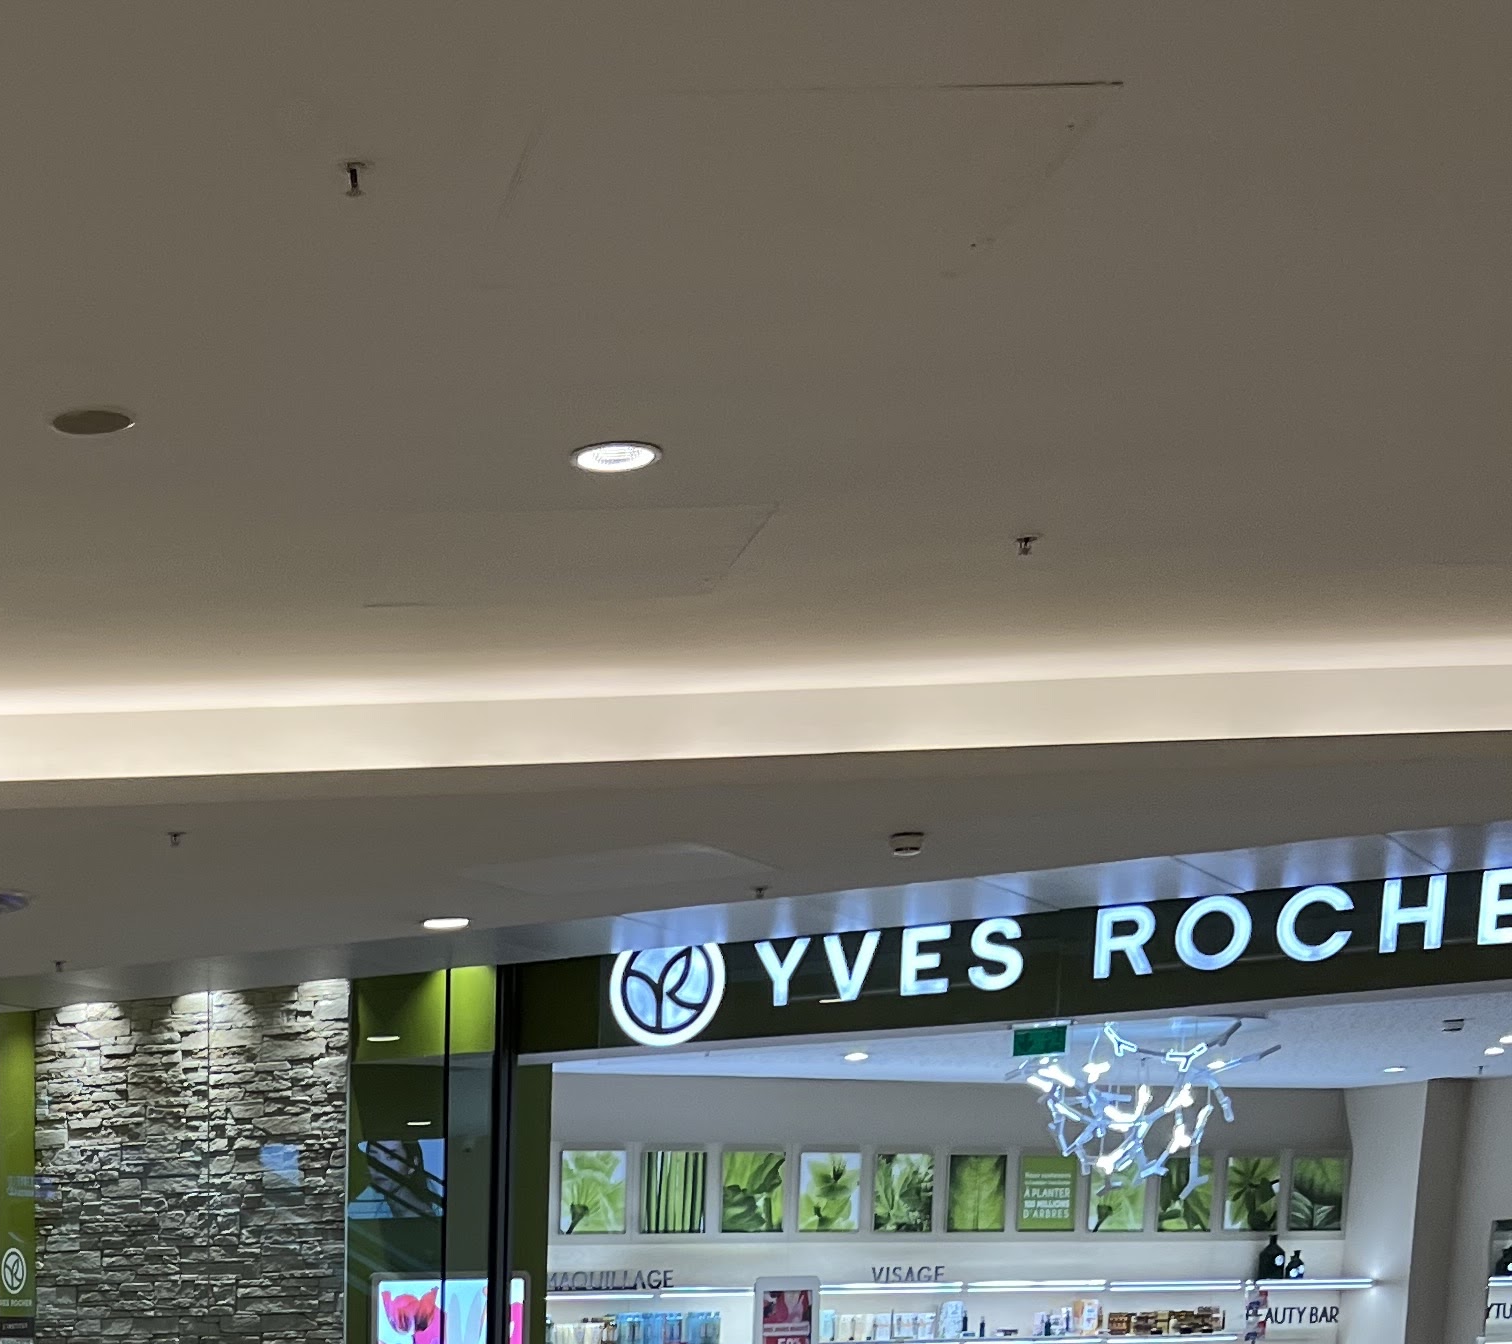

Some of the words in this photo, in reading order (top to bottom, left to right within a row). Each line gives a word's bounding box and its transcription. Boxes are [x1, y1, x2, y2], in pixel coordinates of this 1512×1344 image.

[753, 917, 1025, 1008] YVES
[1092, 869, 1512, 980] ROCHE
[1031, 1187, 1070, 1198] PLANTER
[871, 1265, 945, 1283] VISAGE
[1309, 1305, 1340, 1324] BAR
